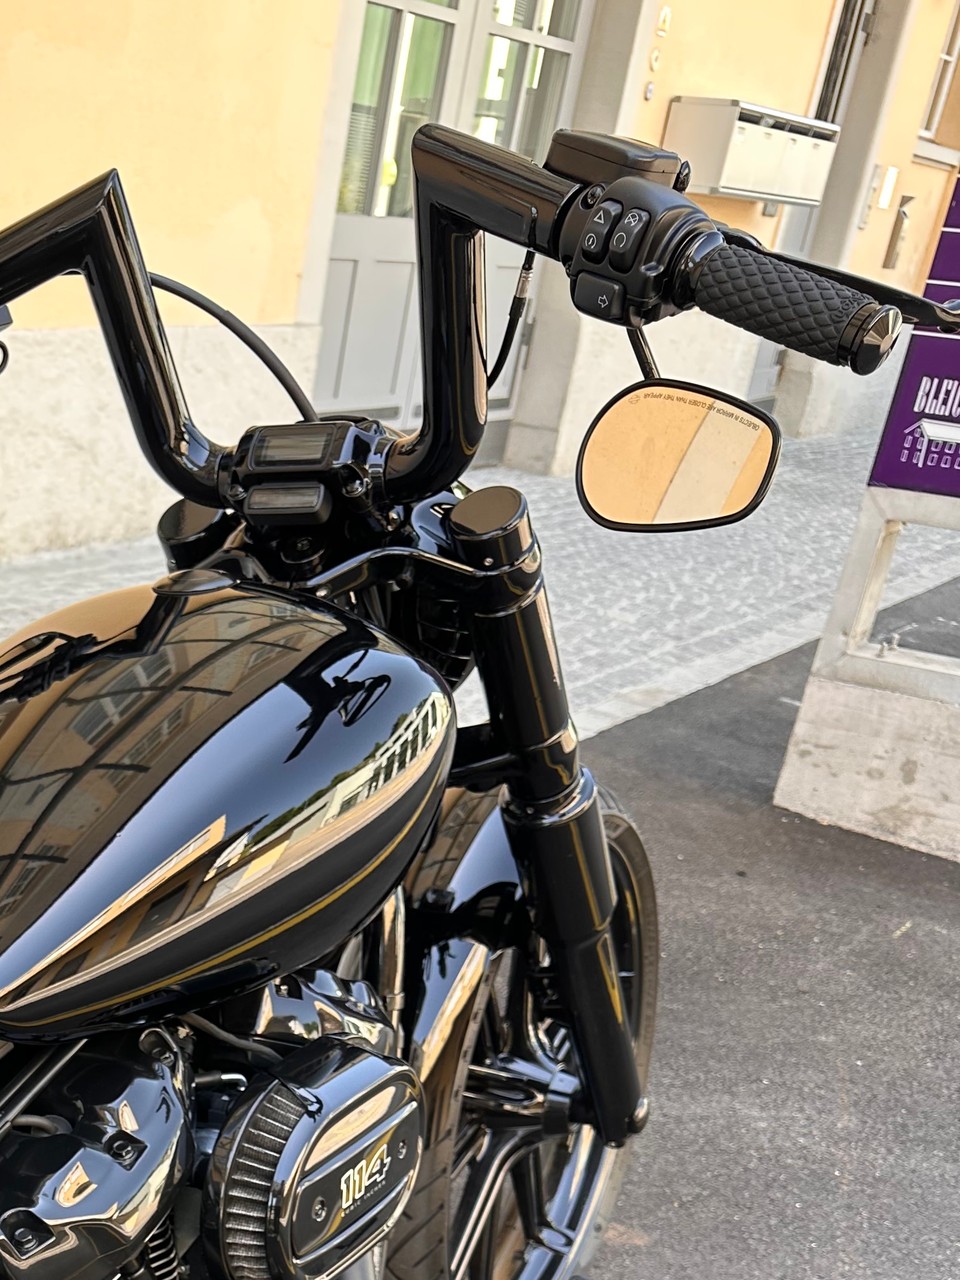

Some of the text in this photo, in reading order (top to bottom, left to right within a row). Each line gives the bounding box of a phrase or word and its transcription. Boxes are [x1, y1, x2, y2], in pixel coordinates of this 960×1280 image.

[675, 396, 688, 404] THAN
[688, 399, 706, 408] CLOSER
[716, 407, 734, 418] MIRROR
[739, 417, 760, 431] OBJECTS
[341, 1144, 392, 1209] 114
